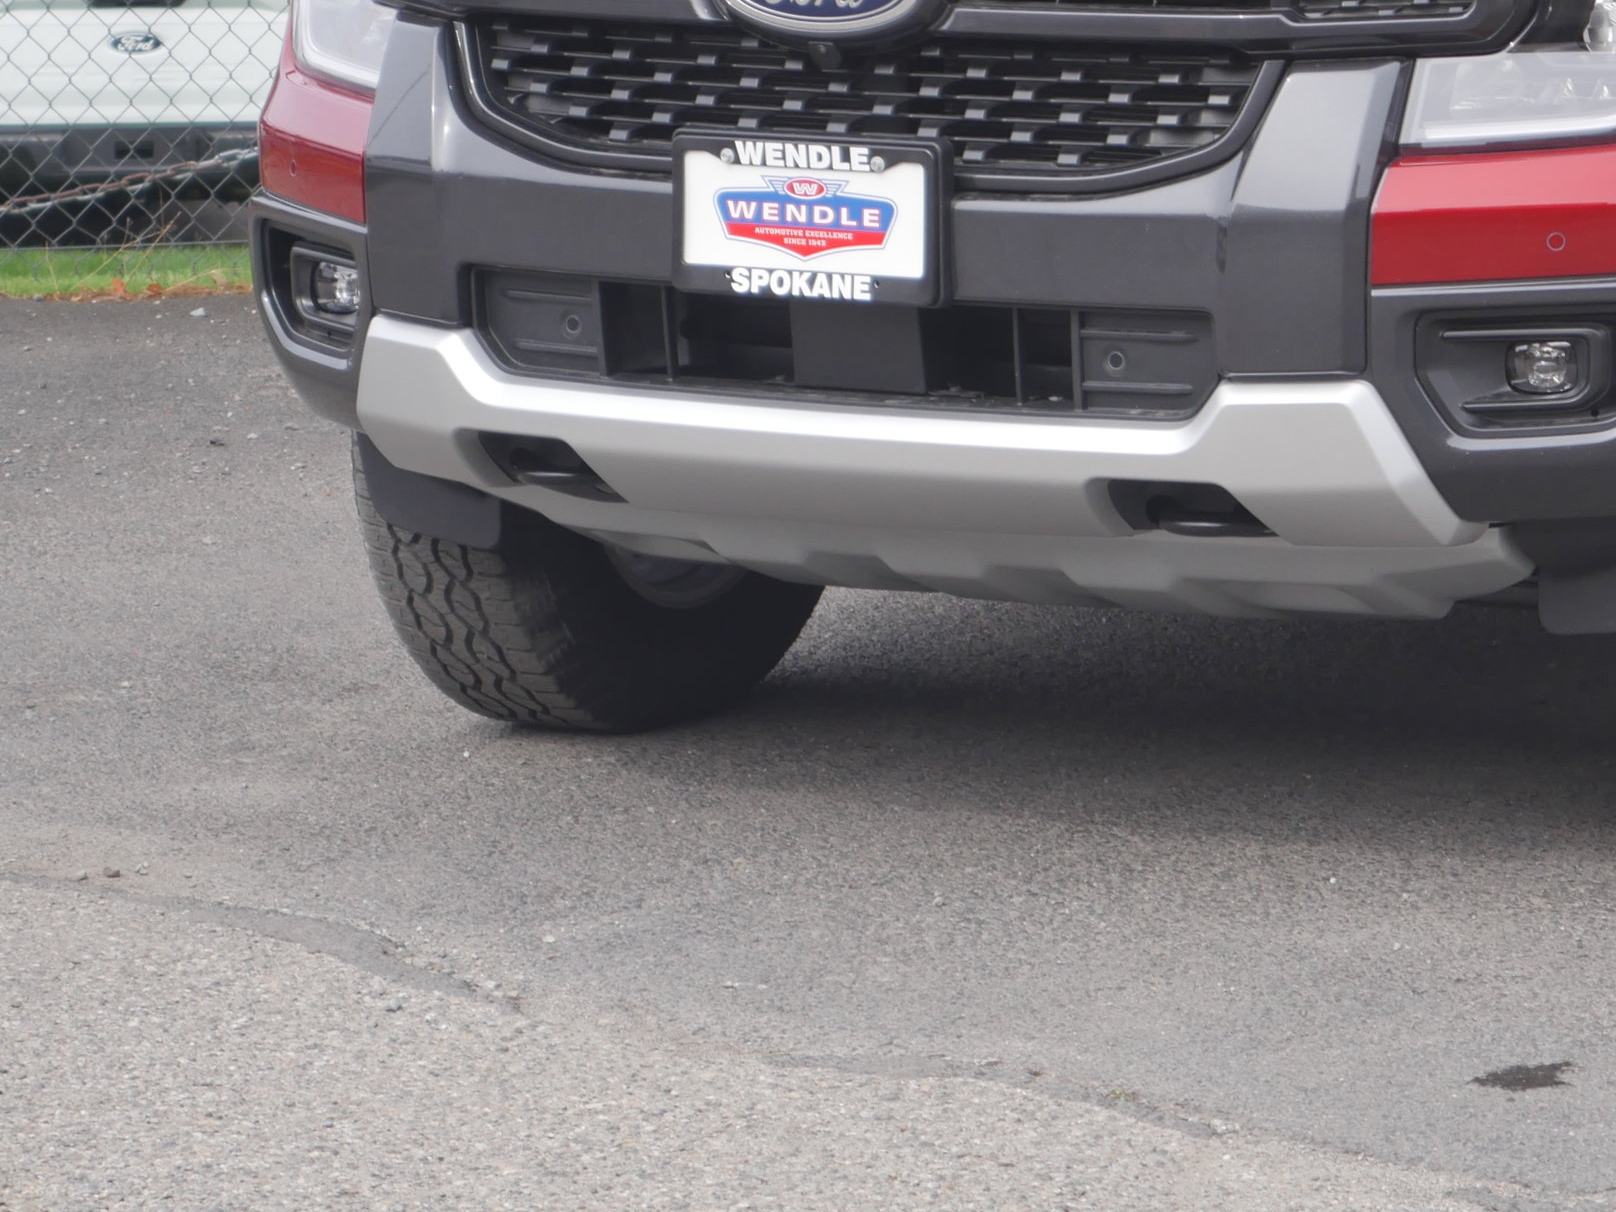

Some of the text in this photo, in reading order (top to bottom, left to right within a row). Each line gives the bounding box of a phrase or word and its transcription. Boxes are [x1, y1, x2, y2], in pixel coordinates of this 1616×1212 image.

[117, 36, 155, 51] Ford
[734, 140, 871, 173] WENDLE
[727, 200, 880, 228] WENDLE
[755, 226, 853, 240] AUTOMOTIVE EXCELLENCE
[784, 237, 826, 247] SINCE 1943
[730, 267, 872, 301] SPOKANE
